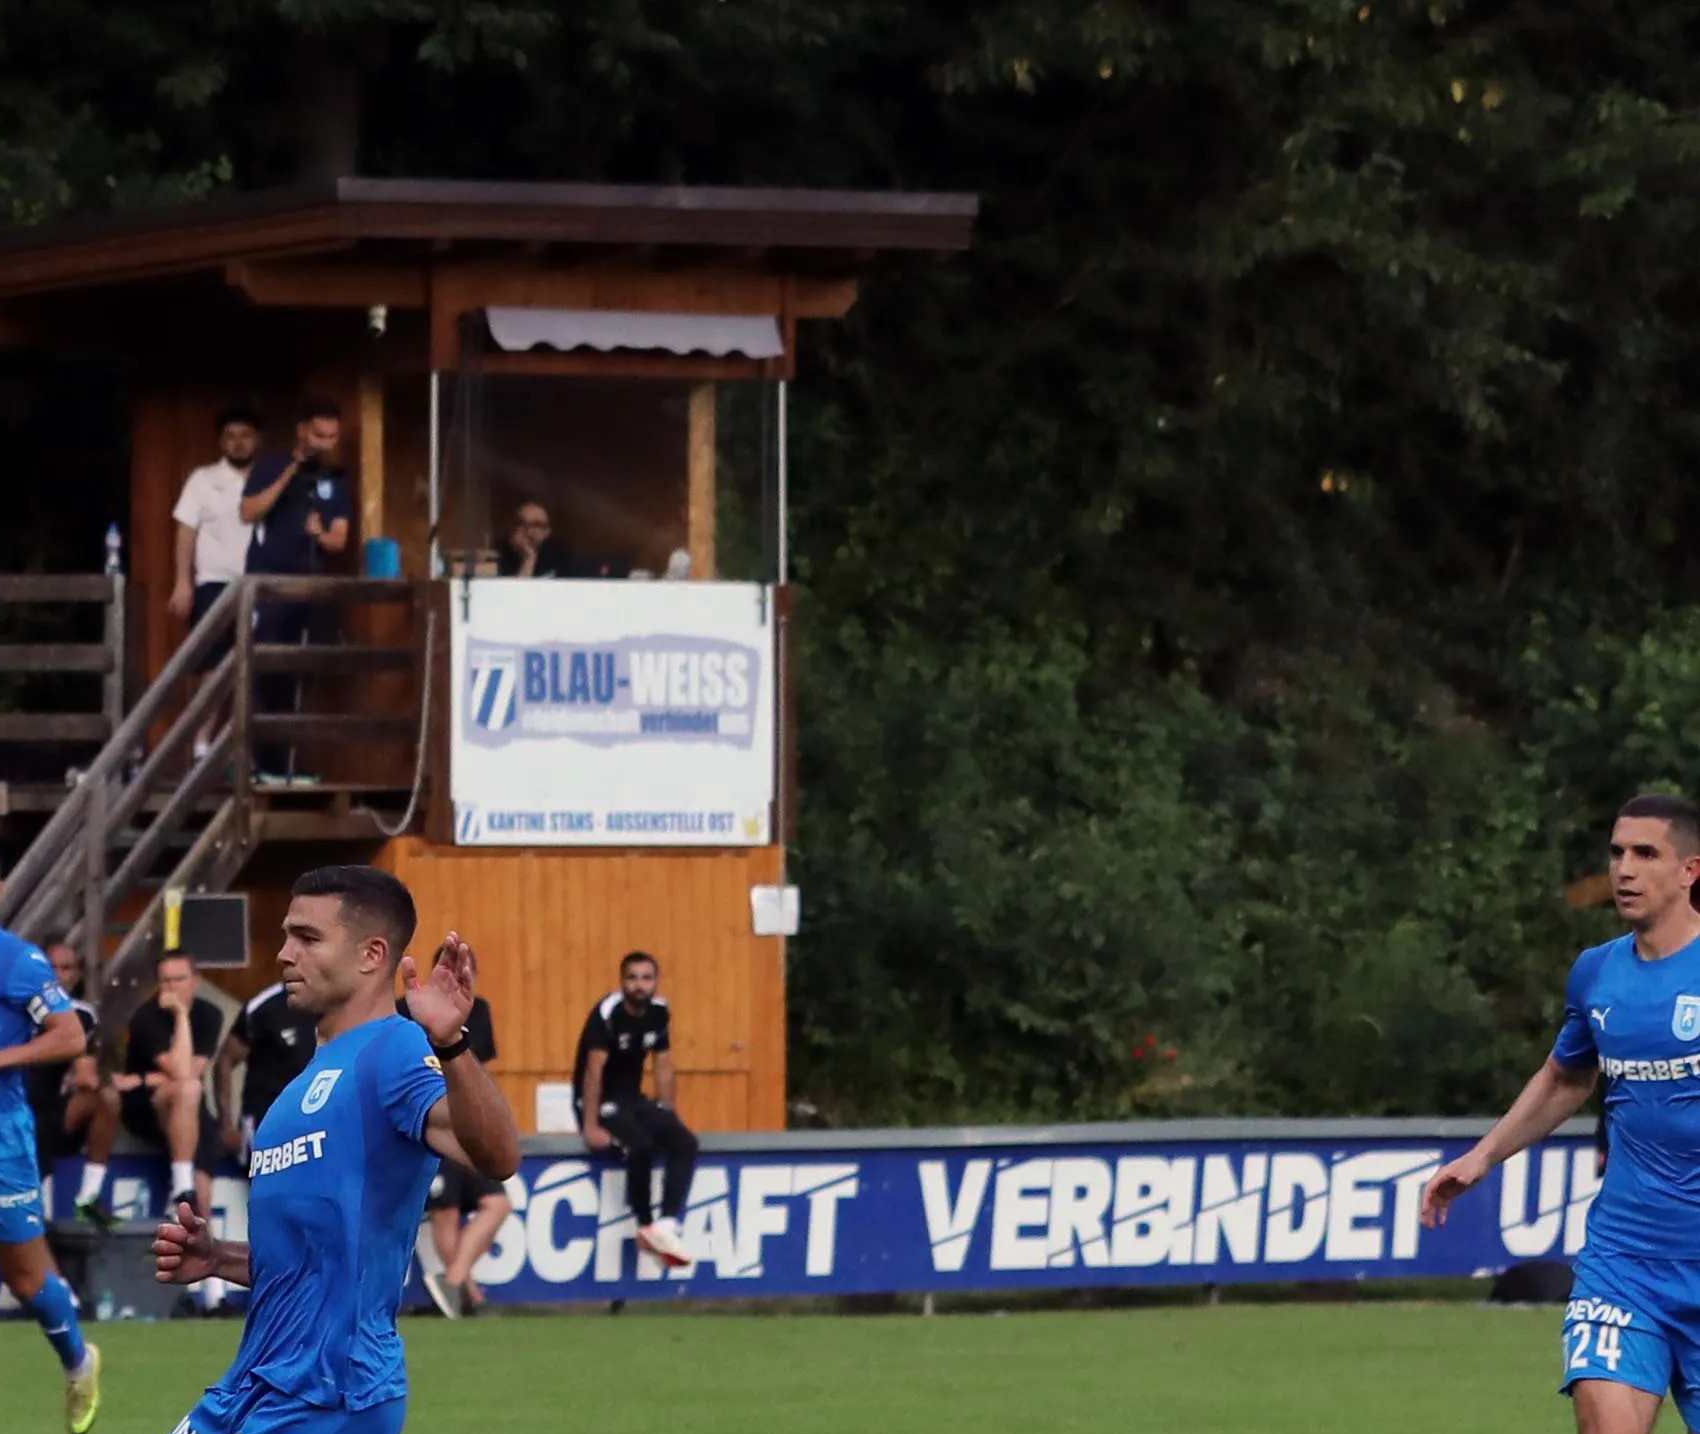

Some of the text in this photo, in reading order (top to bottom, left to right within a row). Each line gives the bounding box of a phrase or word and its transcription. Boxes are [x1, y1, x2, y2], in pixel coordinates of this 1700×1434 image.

[522, 649, 750, 707] BLAU-WEISS
[487, 811, 735, 833] KANTINE STANS AUSSENSTELLE OST
[917, 1149, 1443, 1272] VERBINDET
[1564, 1296, 1633, 1327] DEVIN
[1570, 1322, 1622, 1372] 24
